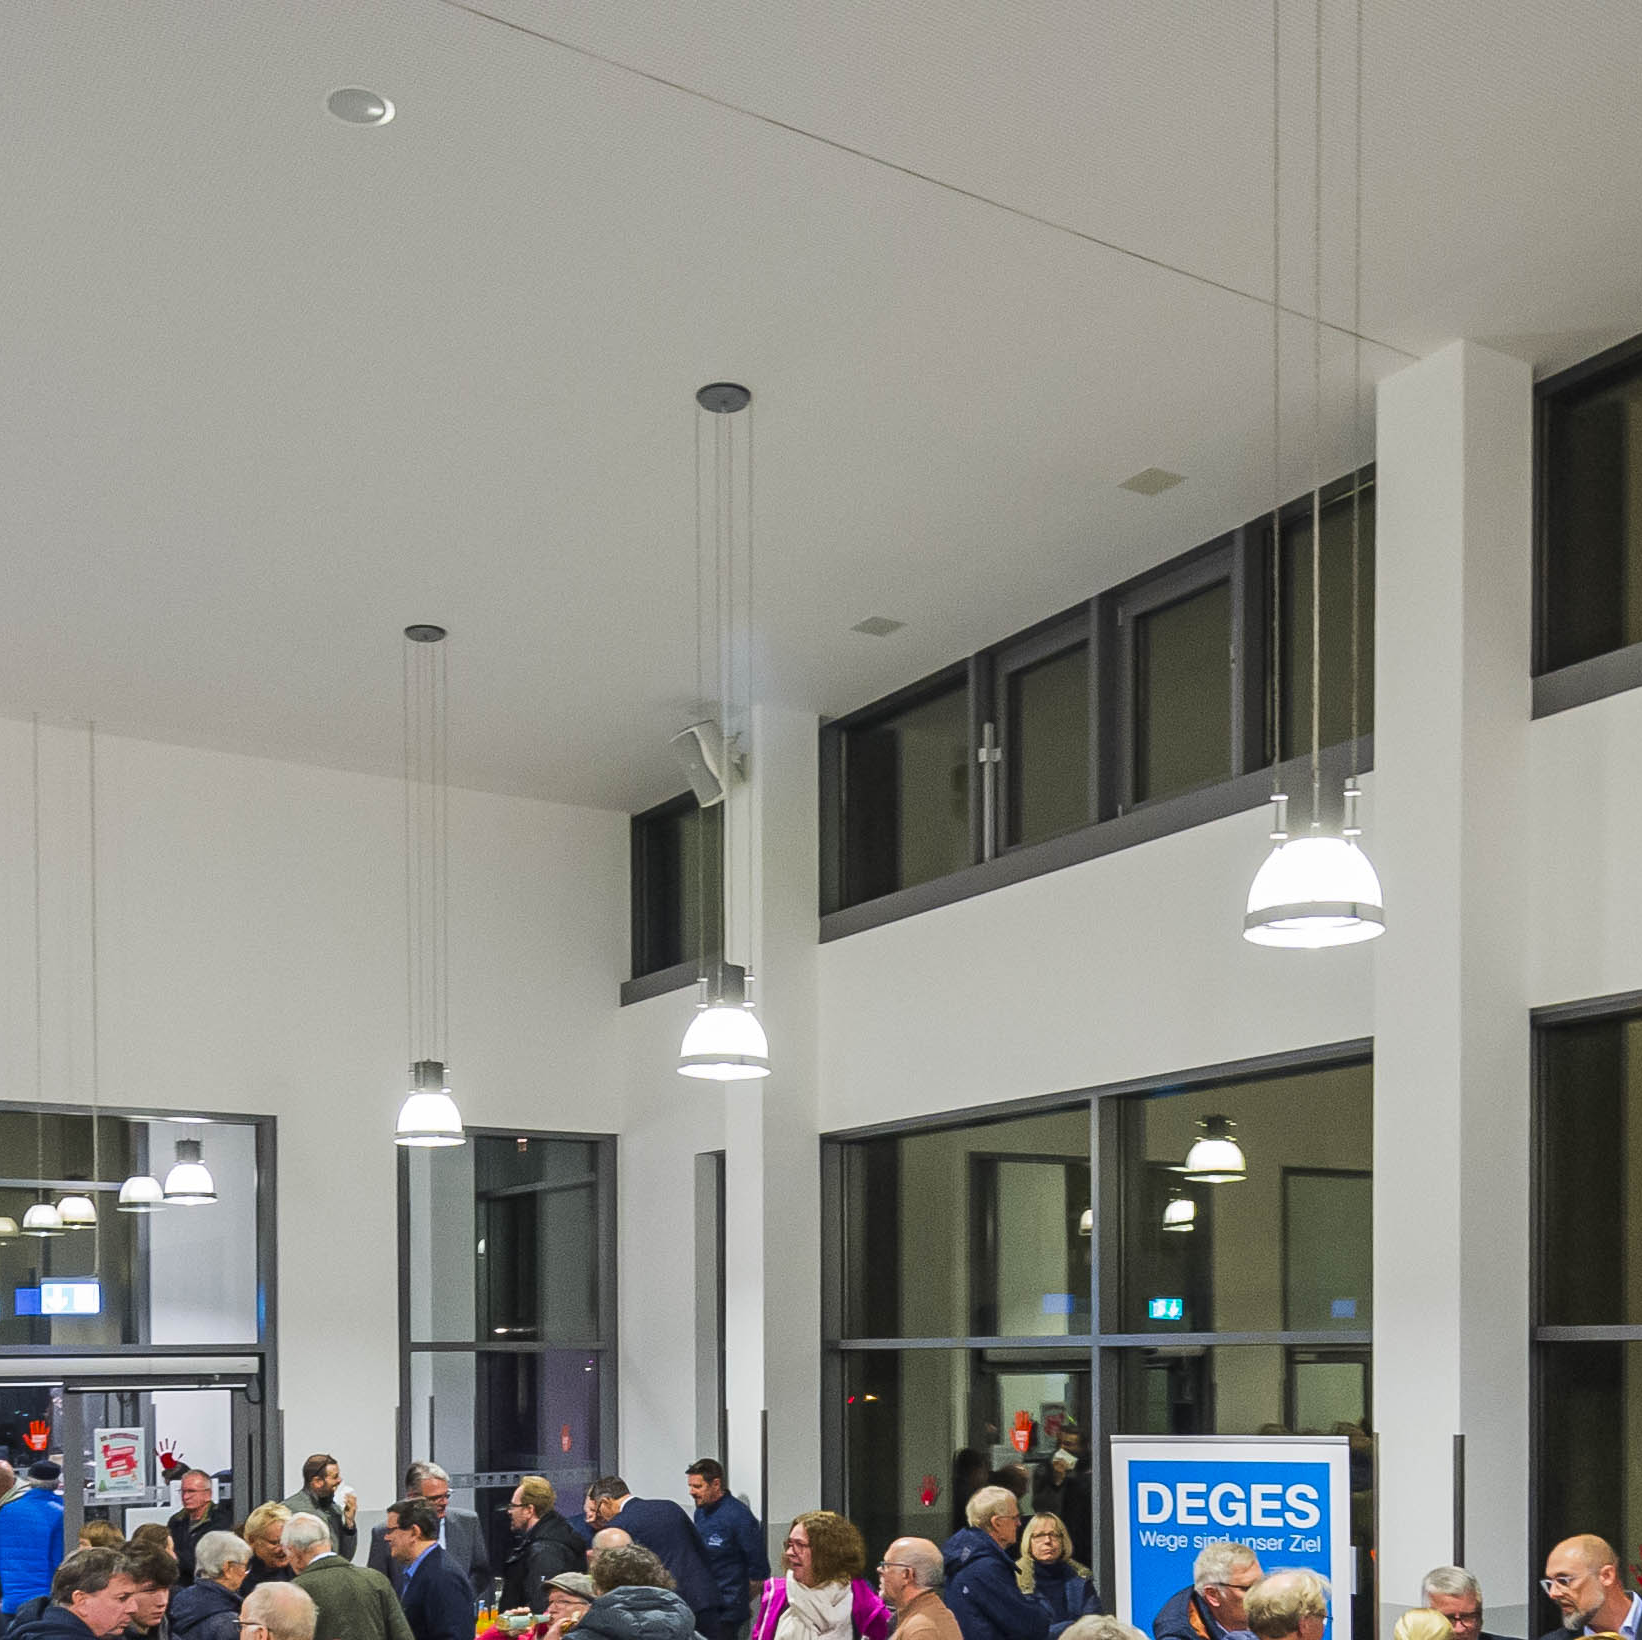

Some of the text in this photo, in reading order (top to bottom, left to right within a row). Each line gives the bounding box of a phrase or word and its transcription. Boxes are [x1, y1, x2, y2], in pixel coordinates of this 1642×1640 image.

[1137, 1482, 1321, 1528] DEGES
[1139, 1530, 1188, 1552] Wege
[1289, 1534, 1321, 1553] Ziel
